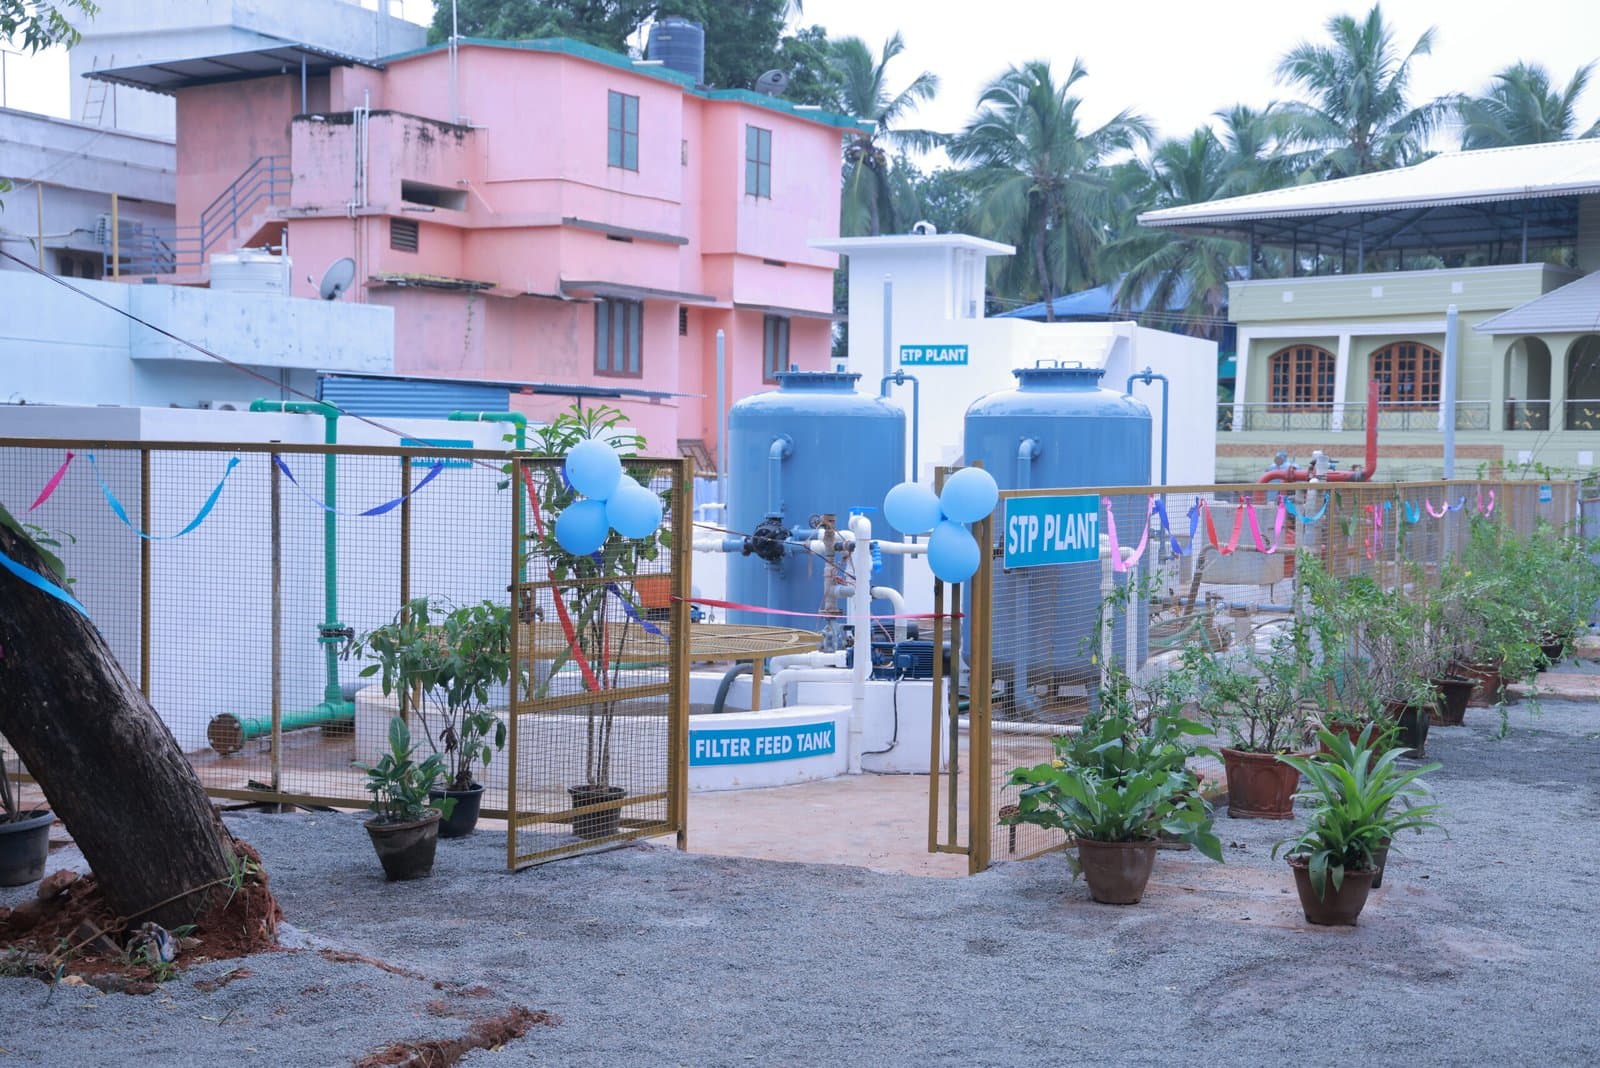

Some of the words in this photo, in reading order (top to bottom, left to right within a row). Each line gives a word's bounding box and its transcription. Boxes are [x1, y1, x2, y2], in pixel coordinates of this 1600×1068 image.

[901, 349, 922, 361] ETP
[926, 349, 966, 361] PLANT
[1009, 515, 1038, 554] STP
[1043, 513, 1097, 551] PLANT
[695, 738, 750, 758] FILTER
[756, 736, 792, 755] FEED
[797, 730, 831, 751] TANK
